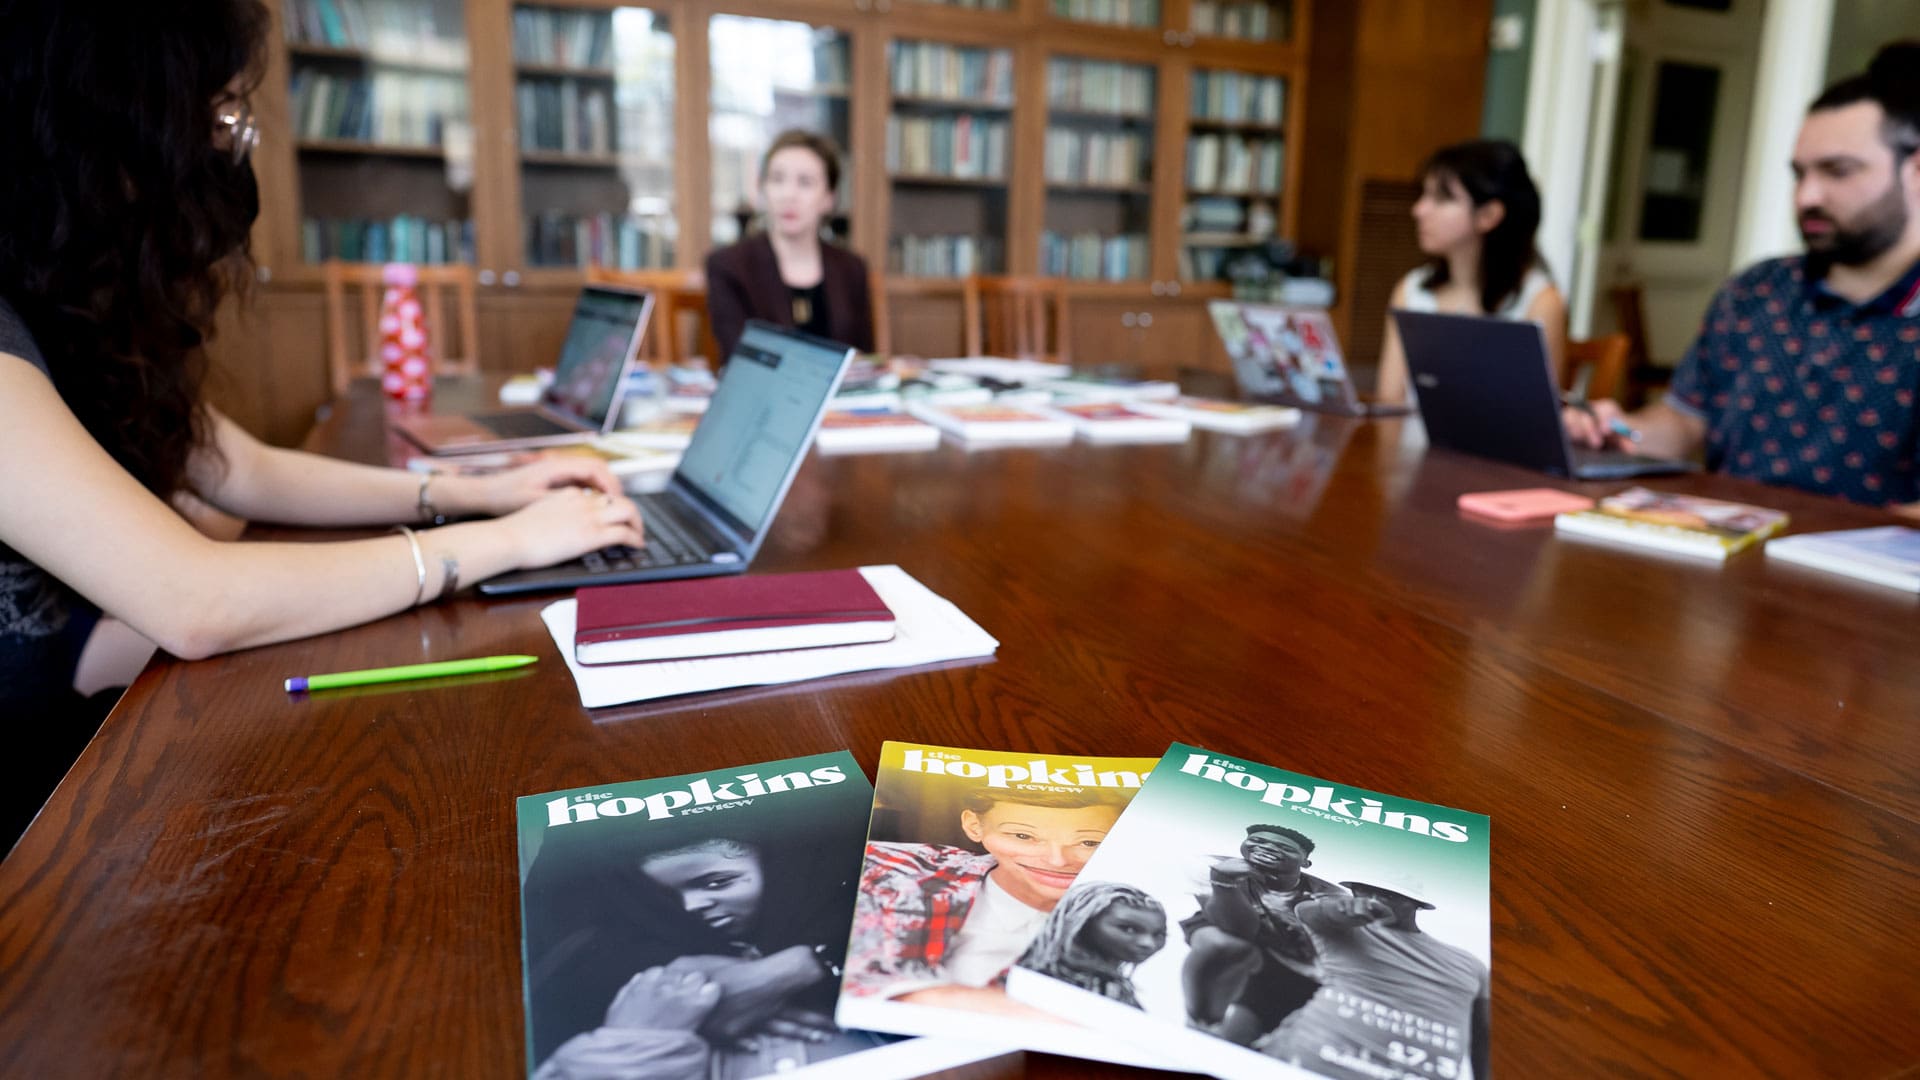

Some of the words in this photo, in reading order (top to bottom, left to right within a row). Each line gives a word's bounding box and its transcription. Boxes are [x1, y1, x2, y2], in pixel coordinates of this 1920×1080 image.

[928, 751, 962, 761] the
[1212, 758, 1246, 772] the
[546, 765, 847, 827] hopkins
[1016, 783, 1085, 794] review
[574, 792, 613, 803] the
[1178, 753, 1469, 843] hopkins
[681, 798, 754, 816] review
[1289, 803, 1363, 828] review
